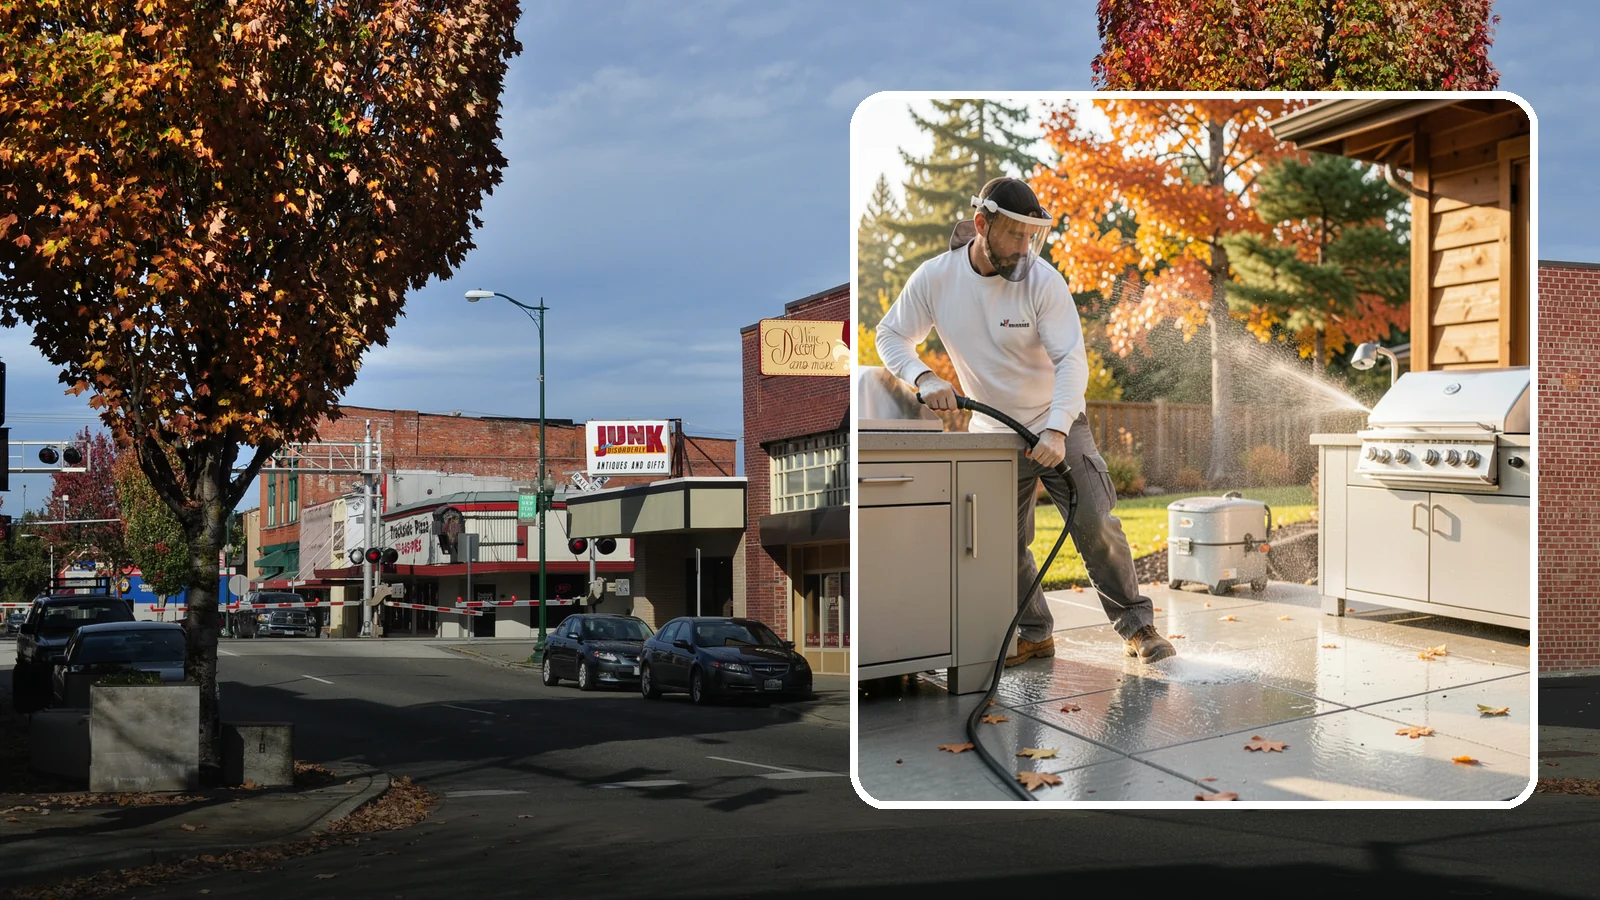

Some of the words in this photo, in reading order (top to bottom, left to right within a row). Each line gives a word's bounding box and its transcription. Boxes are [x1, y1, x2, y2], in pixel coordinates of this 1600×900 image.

[595, 425, 664, 457] JUNK
[607, 446, 646, 454] DISORDERLY
[596, 461, 628, 470] ANTIQUES
[631, 461, 643, 470] AND
[647, 460, 665, 470] GIFTS
[415, 519, 429, 535] Pizza
